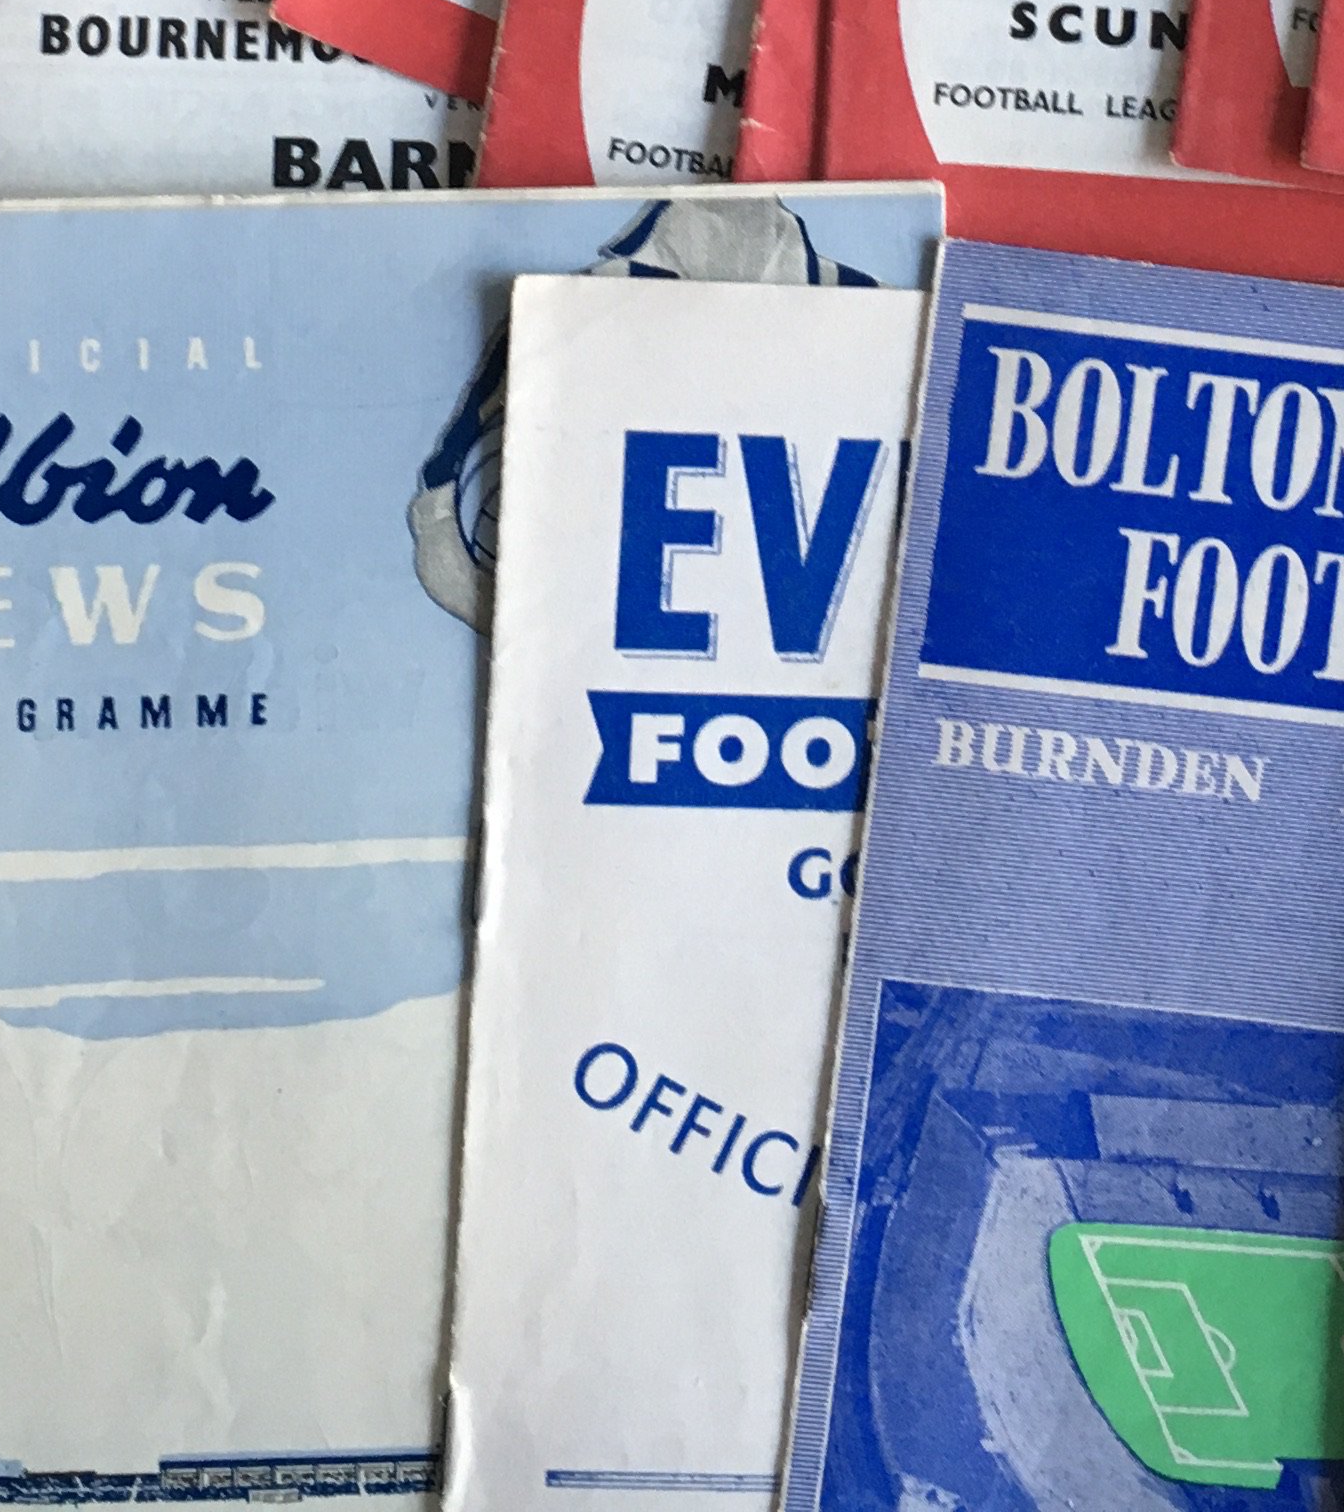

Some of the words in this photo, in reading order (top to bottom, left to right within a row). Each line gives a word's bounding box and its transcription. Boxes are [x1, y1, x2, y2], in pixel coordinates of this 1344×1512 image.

[1008, 0, 1189, 52] SCUN
[932, 80, 1084, 116] FOOTBALL
[934, 719, 1267, 802] BURNDEN
